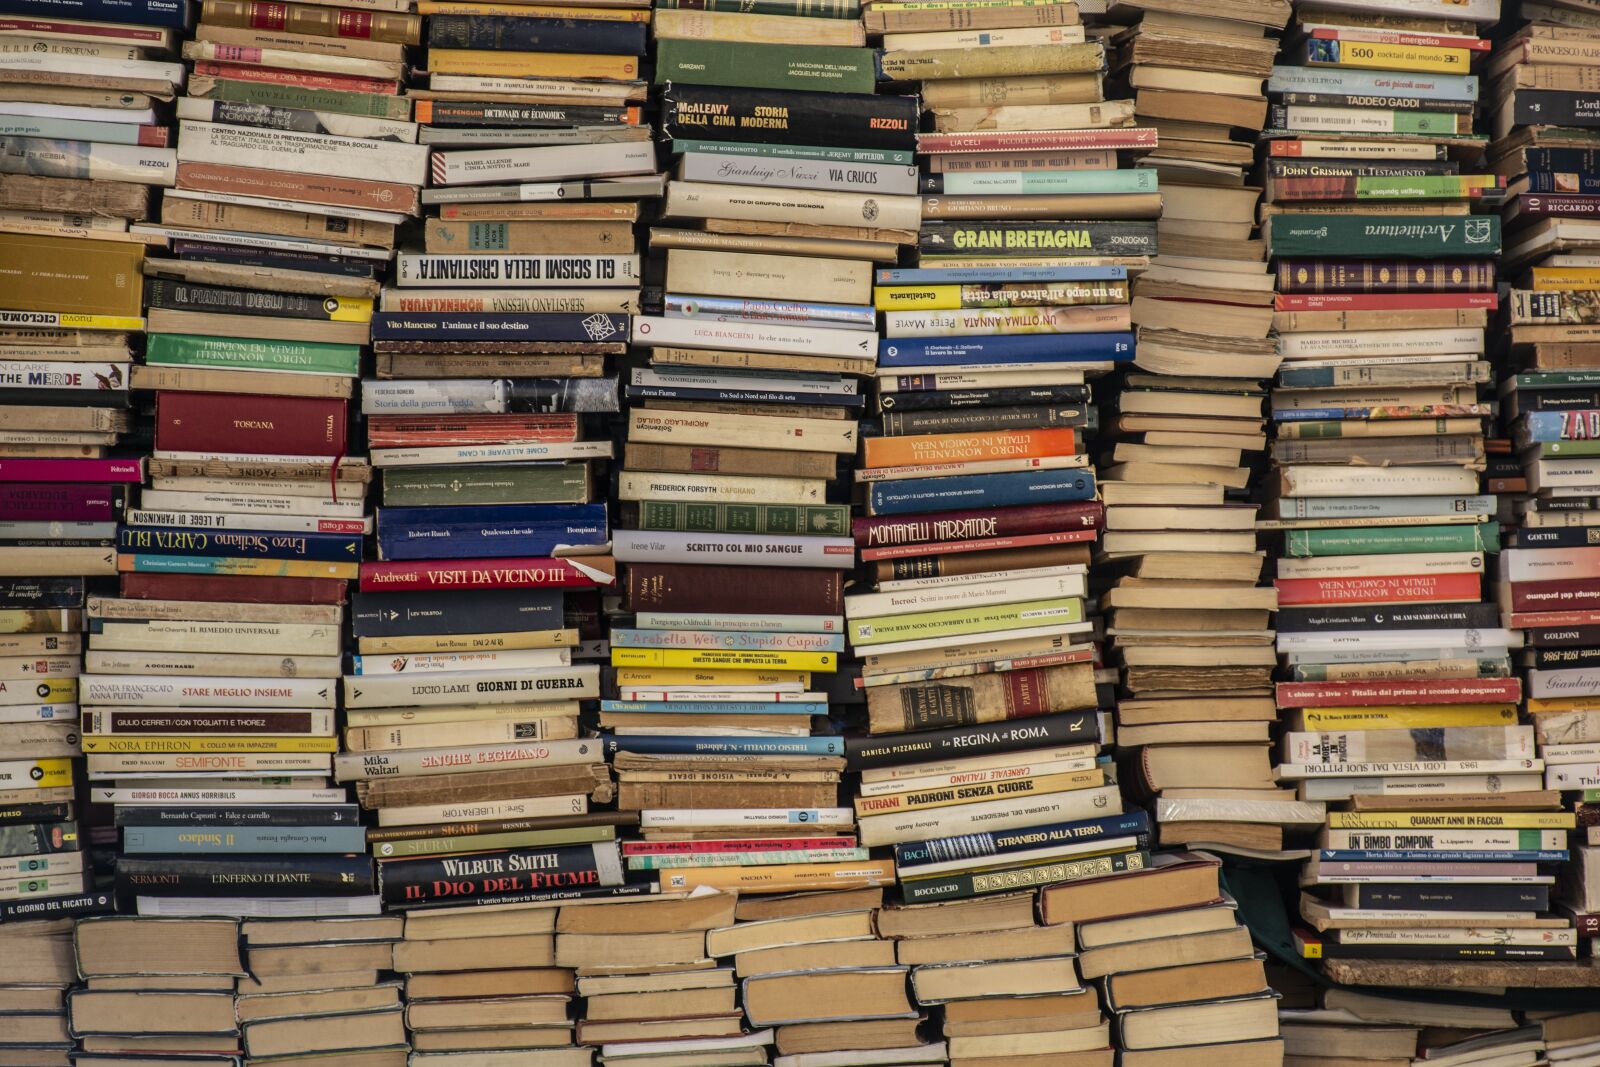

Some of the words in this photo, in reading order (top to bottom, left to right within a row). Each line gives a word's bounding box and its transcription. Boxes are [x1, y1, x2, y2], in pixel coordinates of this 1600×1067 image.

[1379, 35, 1398, 44] yoga
[1401, 37, 1440, 46] energetico
[1351, 48, 1374, 58] 500
[1377, 51, 1404, 59] cocktail
[1347, 96, 1386, 106] TADDEO
[1388, 97, 1419, 108] GADDI
[484, 109, 520, 119] DICTIONARY
[531, 109, 566, 120] ECONOMICS
[678, 103, 729, 115] McALEAVY
[755, 106, 788, 118] STORIA
[678, 115, 707, 125] DELLA
[713, 116, 735, 126] CINA
[740, 117, 788, 129] MODERNA
[870, 118, 907, 130] RIZZOLI
[238, 130, 271, 139] NAZIONALE
[281, 134, 322, 144] PREVENZIONE
[329, 139, 350, 147] DIFESA
[352, 141, 378, 150] SOCIALE
[139, 160, 169, 168] RIZZOLI
[717, 160, 774, 180] Gianluigi
[776, 164, 819, 181] Nuzzi
[829, 169, 844, 182] VIA
[846, 170, 878, 184] CRUCIS
[1283, 166, 1308, 176] JOHN
[1310, 166, 1353, 177] GRISHAM
[1358, 167, 1366, 176] IL
[1369, 168, 1425, 177] TESTAMENTO
[953, 230, 1002, 247] GRAN
[1005, 230, 1092, 248] BRETAGNA
[1365, 224, 1456, 242] Architettura
[1111, 236, 1149, 245] SONZOGNO
[416, 259, 499, 279] CRISTIANITA'
[505, 259, 540, 279] DELLA
[546, 259, 591, 279] SCISMI
[596, 259, 615, 279] GLI
[400, 298, 484, 313] NOMENKLATURA
[493, 298, 529, 311] MESSINA
[531, 298, 585, 311] SEBASTIANO
[387, 321, 402, 329] Vito
[403, 321, 436, 330] Mancuso
[442, 321, 472, 330] L'anima
[480, 321, 485, 329] il
[501, 322, 529, 330] destino
[1, 374, 22, 384] THE
[28, 373, 81, 386] MERDE
[234, 420, 274, 429] TOSCANA
[650, 484, 686, 492] FREDERICK
[687, 485, 716, 493] FORSYTH
[720, 486, 755, 495] L'AFGHANO
[133, 513, 175, 525] PARKINSON
[178, 514, 186, 525] DI
[190, 514, 212, 526] LEGGE
[216, 516, 225, 526] LA
[868, 521, 930, 546] MONTANELLI
[934, 518, 998, 540] NARRATORE
[215, 534, 269, 550] Siciliano
[272, 538, 306, 553] Enzo
[632, 542, 648, 550] Irene
[650, 542, 666, 551] Vilar
[686, 543, 723, 552] SCRITTO
[726, 544, 743, 552] COL
[745, 544, 763, 553] MIO
[764, 544, 803, 554] SANGUE
[373, 572, 417, 583] Andreotti
[427, 571, 466, 584] VISTI
[472, 571, 493, 583] DA
[496, 569, 545, 583] VICINO
[548, 568, 566, 581] III
[1319, 581, 1344, 589] NERA
[1346, 580, 1386, 588] CAMICIA
[1403, 578, 1436, 587] L'ITALIA
[1321, 587, 1388, 598] MONTANELLI
[1396, 587, 1434, 596] INDRO
[632, 633, 687, 644] Arabella
[692, 634, 719, 645] Weir
[739, 634, 782, 646] Stupido
[787, 637, 830, 646] Cupido
[1544, 632, 1580, 640] GOLDONI
[182, 688, 210, 697] STARE
[213, 688, 252, 697] MEGLIO
[254, 688, 293, 697] INSIEME
[412, 685, 441, 695] LUCIO
[443, 684, 469, 693] LAMI
[476, 681, 517, 692] GIORNI
[521, 681, 532, 690] DI
[536, 678, 584, 689] GUERRA
[953, 733, 1000, 748] REGINA
[1010, 726, 1049, 740] ROMA
[861, 747, 891, 757] DANIELA
[893, 742, 932, 752] PIZZAGALLI
[176, 757, 246, 768] SEMIFONTE
[364, 756, 389, 766] Mika
[420, 754, 471, 768] SINUHE
[476, 749, 549, 764] L'EGIZIANO
[364, 765, 400, 776] Waltari
[131, 791, 157, 799] GIORGIO
[158, 791, 179, 799] BOCCA
[180, 791, 199, 799] ANNUS
[201, 791, 236, 799] HORRIBILIS
[861, 798, 900, 811] TURANI
[907, 791, 954, 805] PADRONI
[958, 786, 994, 799] SENZA
[998, 780, 1034, 794] CUORE
[997, 832, 1047, 848] STRANIERO
[1049, 829, 1072, 840] ALLA
[1072, 825, 1103, 837] TERRA
[1349, 836, 1361, 849] UN
[1364, 836, 1391, 849] BIMBO
[1393, 836, 1434, 849] COMPONE
[904, 850, 929, 860] BACH
[441, 858, 503, 877] WILBUR
[508, 853, 559, 871] SMITH
[130, 874, 180, 884] SERMONTI
[212, 874, 262, 884] L'INFERNO
[264, 874, 275, 883] DI
[276, 873, 311, 883] DANTE
[405, 886, 425, 899] IL
[432, 880, 475, 897] DIO
[484, 878, 523, 893] DEL
[530, 870, 599, 889] FIUME
[914, 884, 958, 896] BOCCACCIO
[8, 905, 14, 914] IL
[17, 903, 44, 913] GIORNO
[46, 902, 60, 911] DEL
[62, 898, 93, 910] RICATTO
[1346, 930, 1364, 939] Cape
[1366, 930, 1397, 939] Peninsula
